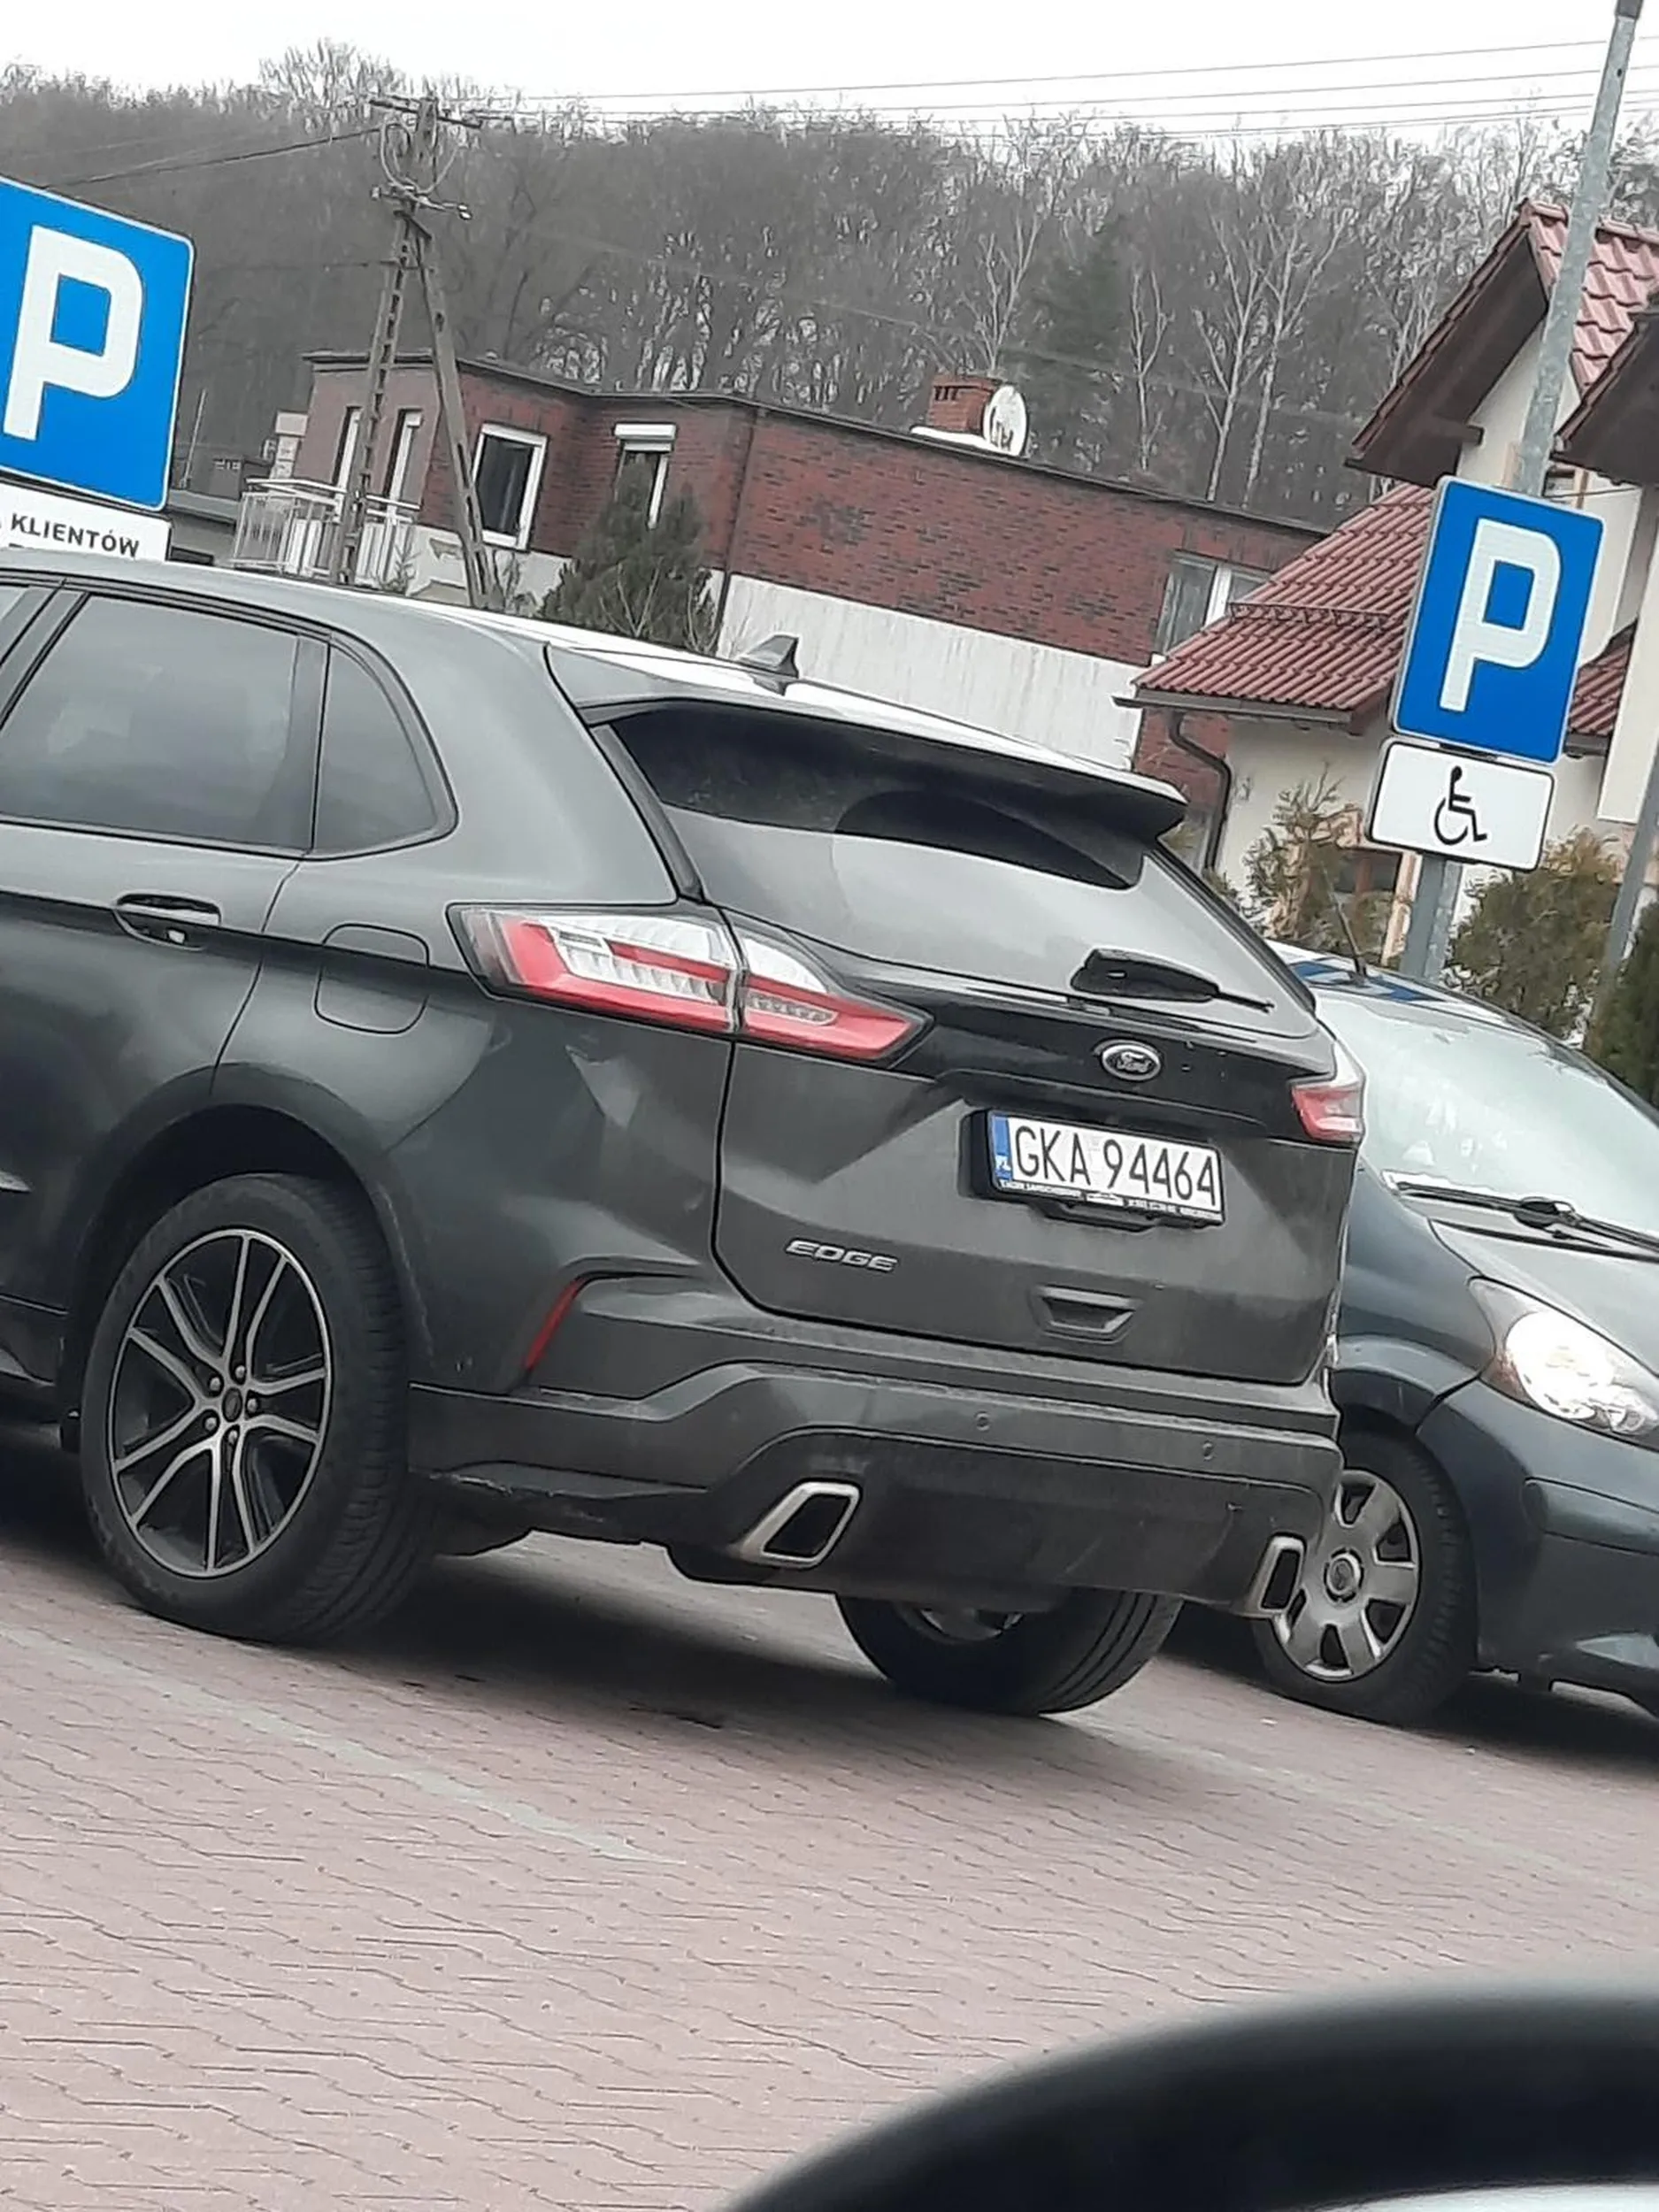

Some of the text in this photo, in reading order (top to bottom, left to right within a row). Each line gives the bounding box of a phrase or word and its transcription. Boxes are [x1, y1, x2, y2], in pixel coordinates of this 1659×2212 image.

[4, 225, 143, 441] P
[11, 513, 139, 557] KLIENTÓW
[1440, 518, 1561, 711] P
[1014, 1125, 1216, 1206] GKA 94464
[786, 1240, 898, 1271] EDGE
